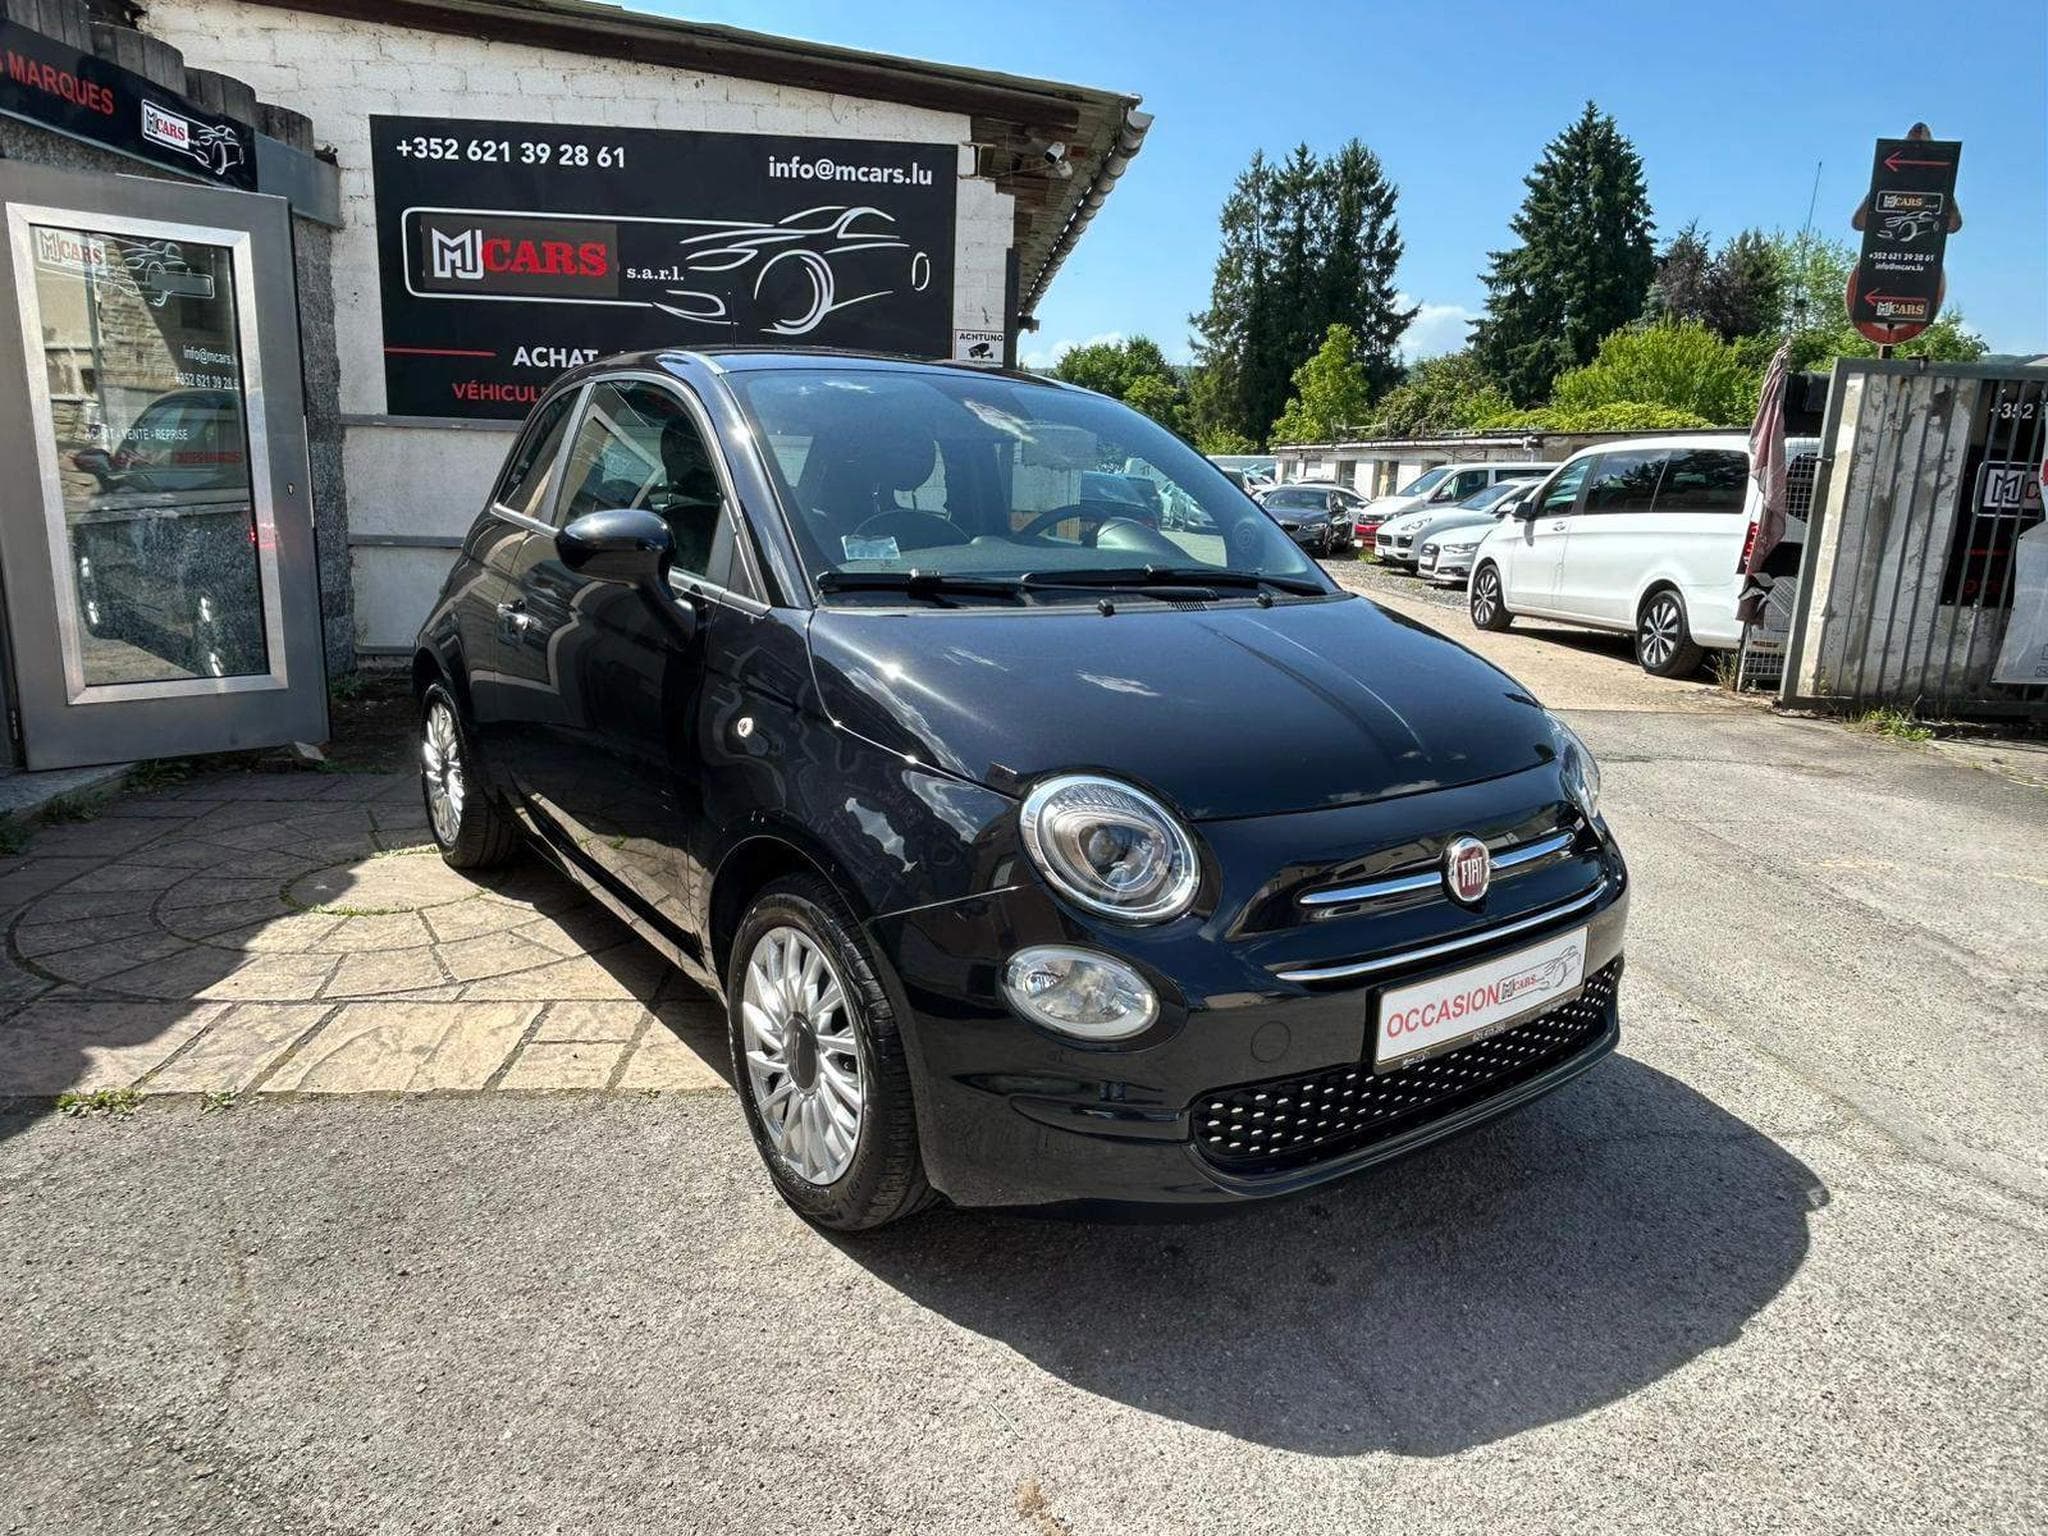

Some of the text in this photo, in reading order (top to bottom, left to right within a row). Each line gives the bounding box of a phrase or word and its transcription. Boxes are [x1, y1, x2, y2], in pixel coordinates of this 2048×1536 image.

[7, 50, 115, 115] MARQUES
[396, 137, 626, 168] +352 621 39 28 61
[768, 156, 933, 186] info@mcars.lu
[481, 237, 609, 278] CARS
[626, 264, 685, 281] s.a.r.l.
[959, 332, 1004, 342] ACHTUNG
[451, 379, 547, 403] VÉHICUL
[1461, 856, 1483, 888] FIAT
[1386, 983, 1500, 1038] OCCASION
